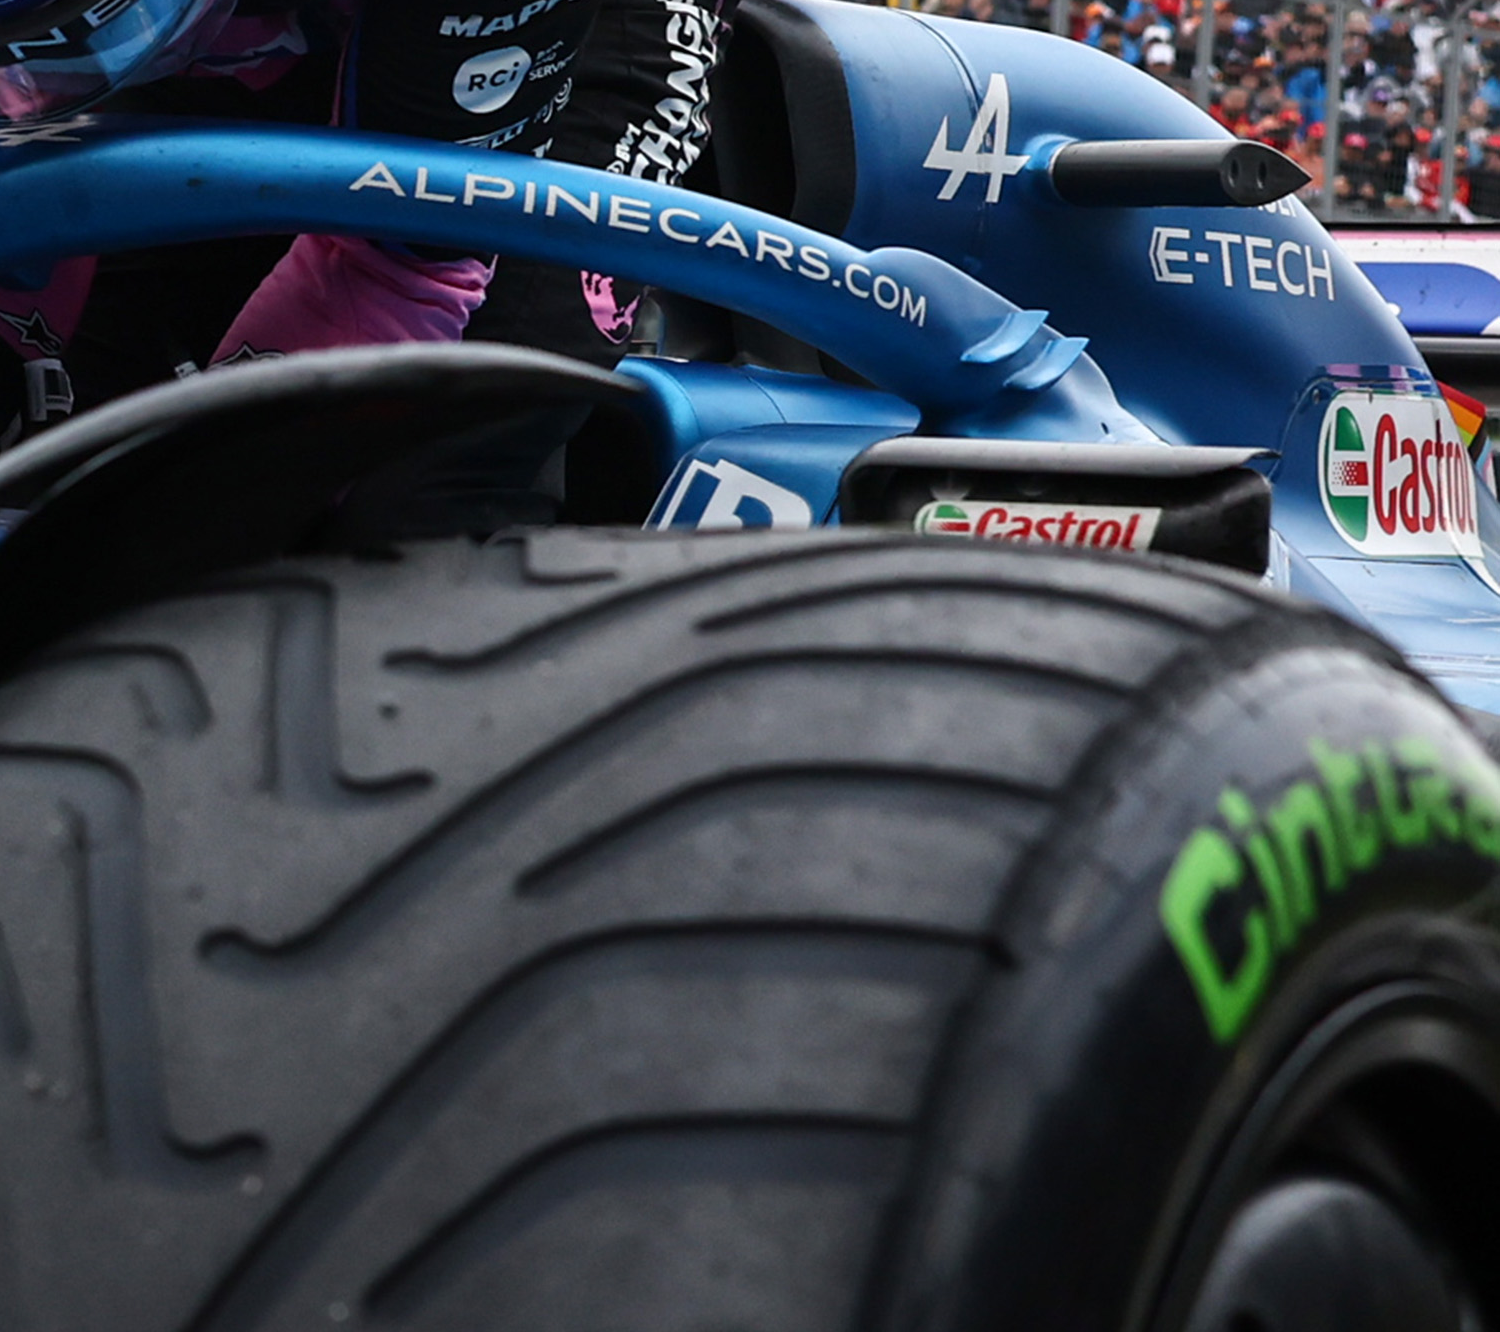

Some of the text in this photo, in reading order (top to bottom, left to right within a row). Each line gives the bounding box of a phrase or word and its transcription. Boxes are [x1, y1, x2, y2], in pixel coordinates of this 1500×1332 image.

[348, 161, 929, 328] ALPINECARS.COM
[1147, 225, 1336, 302] E-TECH
[1372, 412, 1479, 536] Castrol
[974, 506, 1142, 553] Castrol
